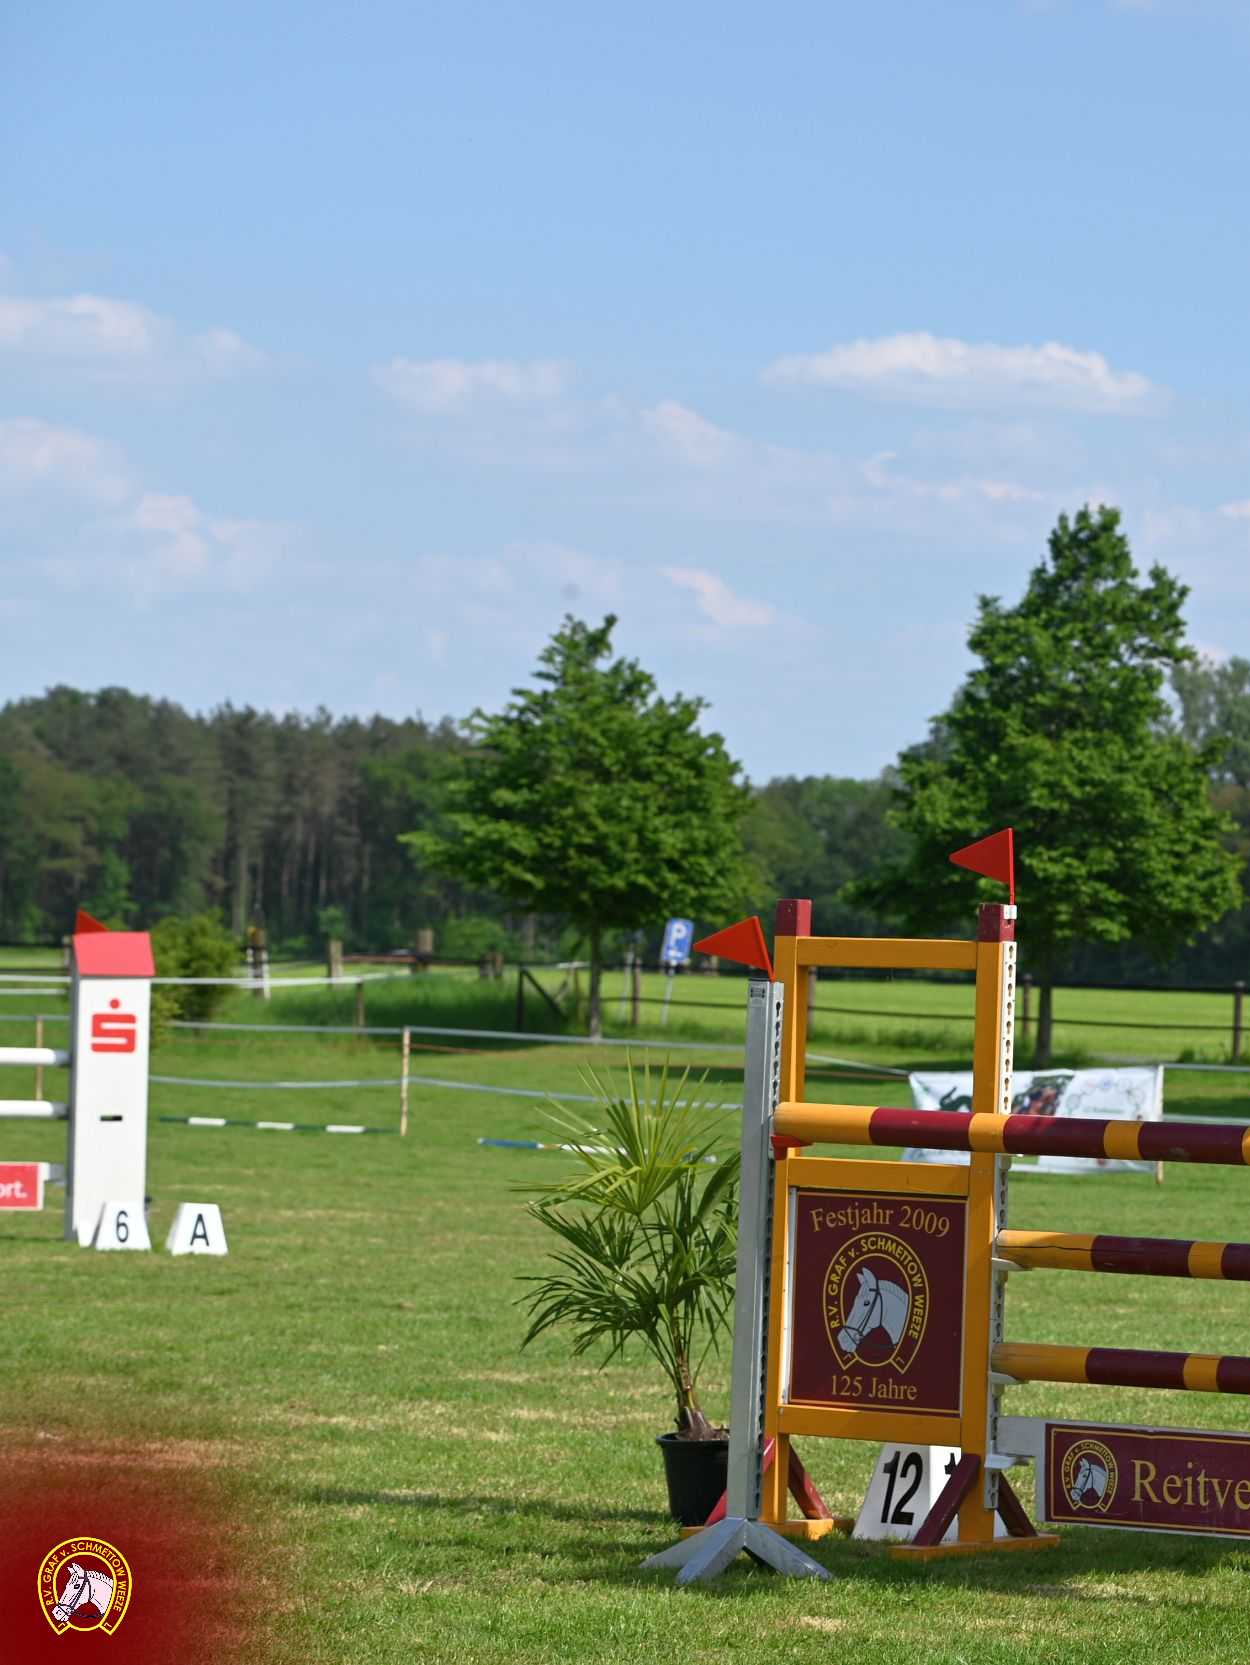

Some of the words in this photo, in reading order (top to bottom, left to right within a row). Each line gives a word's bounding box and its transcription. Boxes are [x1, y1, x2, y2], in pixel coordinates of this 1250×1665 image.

[116, 1210, 129, 1243] 6
[190, 1213, 210, 1246] A
[810, 1202, 894, 1232] Festjahr
[899, 1205, 950, 1238] 2009
[828, 1256, 847, 1296] GRAF
[860, 1237, 922, 1287] SCHMETTOW
[909, 1294, 925, 1339] WEEZE
[831, 1375, 862, 1396] 125
[868, 1377, 918, 1400] Jahre
[881, 1451, 923, 1526] 12
